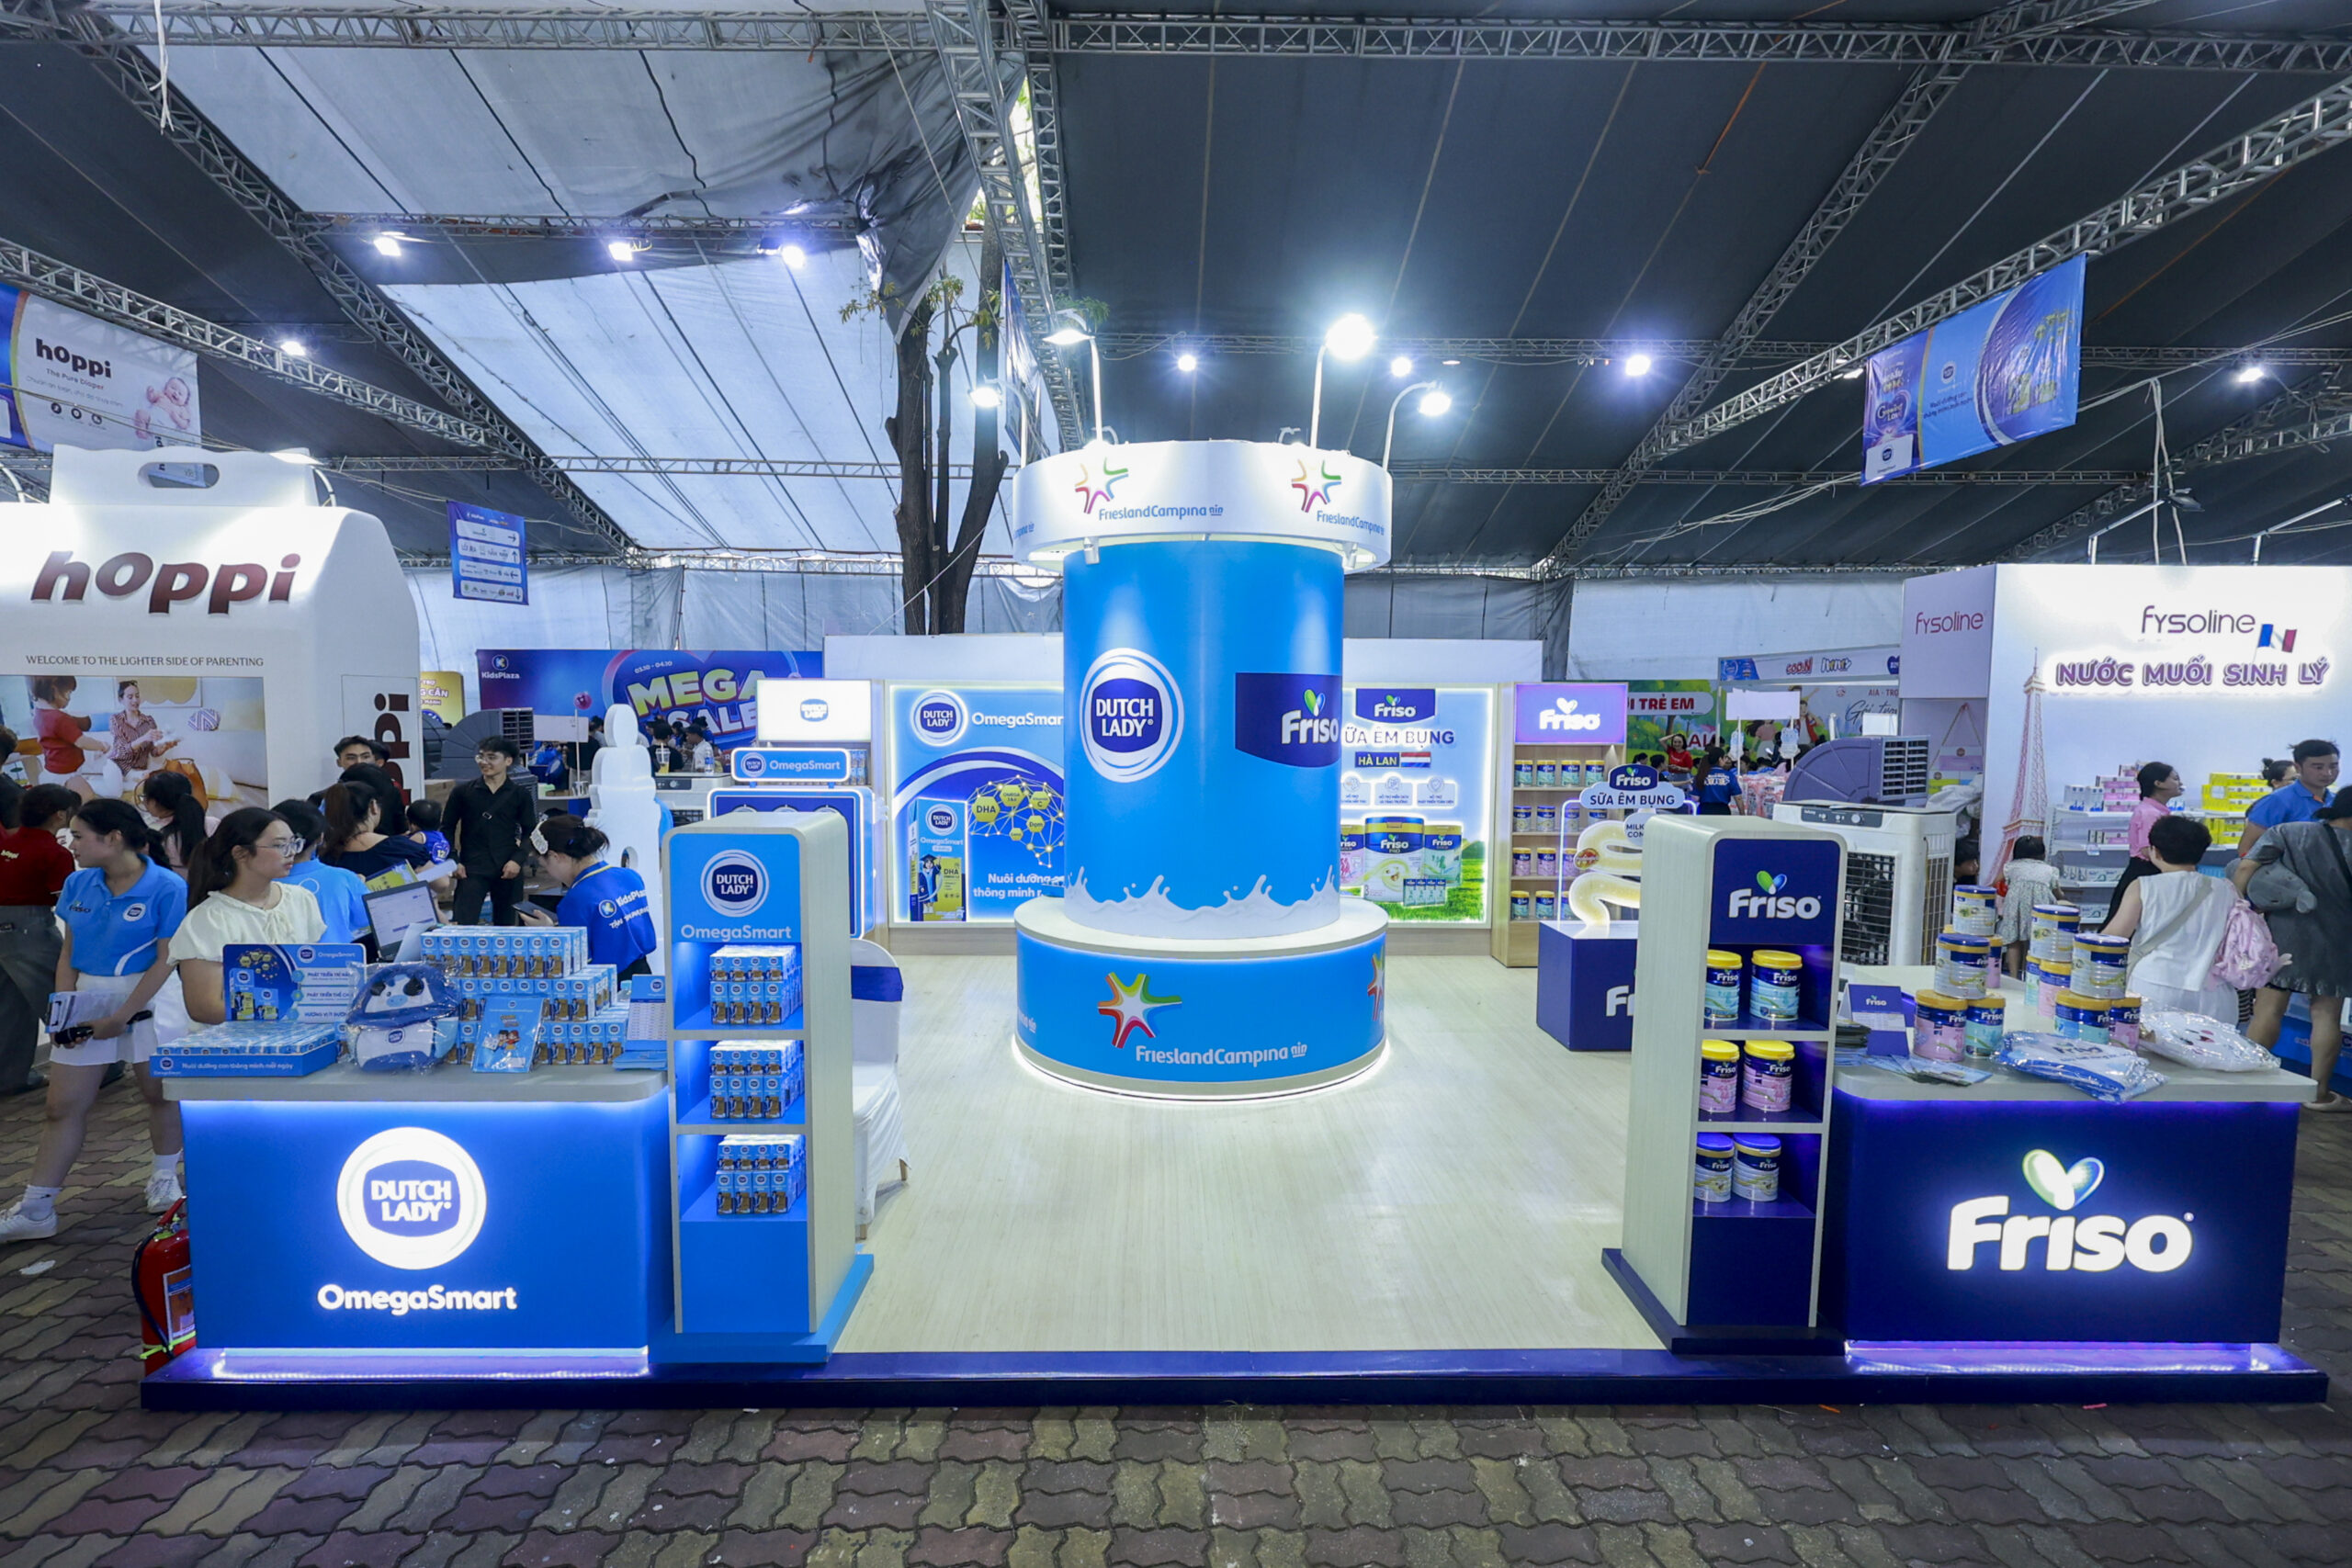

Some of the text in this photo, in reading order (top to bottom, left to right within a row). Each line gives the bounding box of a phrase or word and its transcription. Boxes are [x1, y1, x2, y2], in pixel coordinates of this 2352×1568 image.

[36, 337, 111, 378] hoppi
[1099, 504, 1207, 521] FrieslandCampina
[31, 550, 301, 615] hoppi
[1915, 610, 1984, 636] fysoline
[2141, 604, 2256, 635] fysoline
[26, 655, 264, 667] WELCOME TO THE LIGHTER SIDE OF PARENTING
[481, 671, 520, 680] KidsPlaza
[2055, 653, 2329, 687] NƯỚC MUỐI SINH LÝ
[628, 668, 768, 717] MEGA
[1096, 697, 1154, 718] DUTCH
[1639, 693, 1667, 710] TRẺ
[1670, 697, 1694, 710] EM
[923, 710, 954, 718] DUTCH
[1374, 703, 1417, 717] Friso
[926, 718, 951, 728] LADY
[971, 712, 1064, 728] OmegaSmar
[1101, 716, 1147, 738] LADY
[1281, 709, 1340, 745] Friso
[1539, 709, 1600, 731] Friso
[1344, 726, 1455, 749] ỮA ÊM BỤNG
[769, 759, 841, 772] OmegaSmart
[1358, 753, 1397, 765] HÀ LAN
[1615, 773, 1651, 786] Friso
[1589, 791, 1675, 808] SỮA ÊM BỤNG
[976, 806, 996, 814] DHA
[1380, 839, 1408, 850] Friso
[716, 874, 753, 885] DUTCH
[988, 873, 1013, 884] Nuôi
[720, 885, 749, 895] LADY
[973, 886, 1005, 899] thông
[1007, 886, 1036, 897] minh
[1728, 888, 1821, 919] Friso
[681, 924, 792, 942] OmegaSmart
[1716, 972, 1739, 981] Friso
[1773, 972, 1797, 982] Friso
[1866, 998, 1886, 1006] Friso
[1949, 1015, 1966, 1023] Fris
[2098, 1015, 2110, 1023] Fri
[1136, 1044, 1288, 1067] FrieslandCampina
[1715, 1065, 1736, 1073] Friso
[1770, 1064, 1791, 1073] Friso
[371, 1179, 452, 1201] DUTCH
[381, 1201, 443, 1222] LADY
[1946, 1194, 2194, 1272] Friso
[317, 1284, 517, 1316] OmegaSmart
